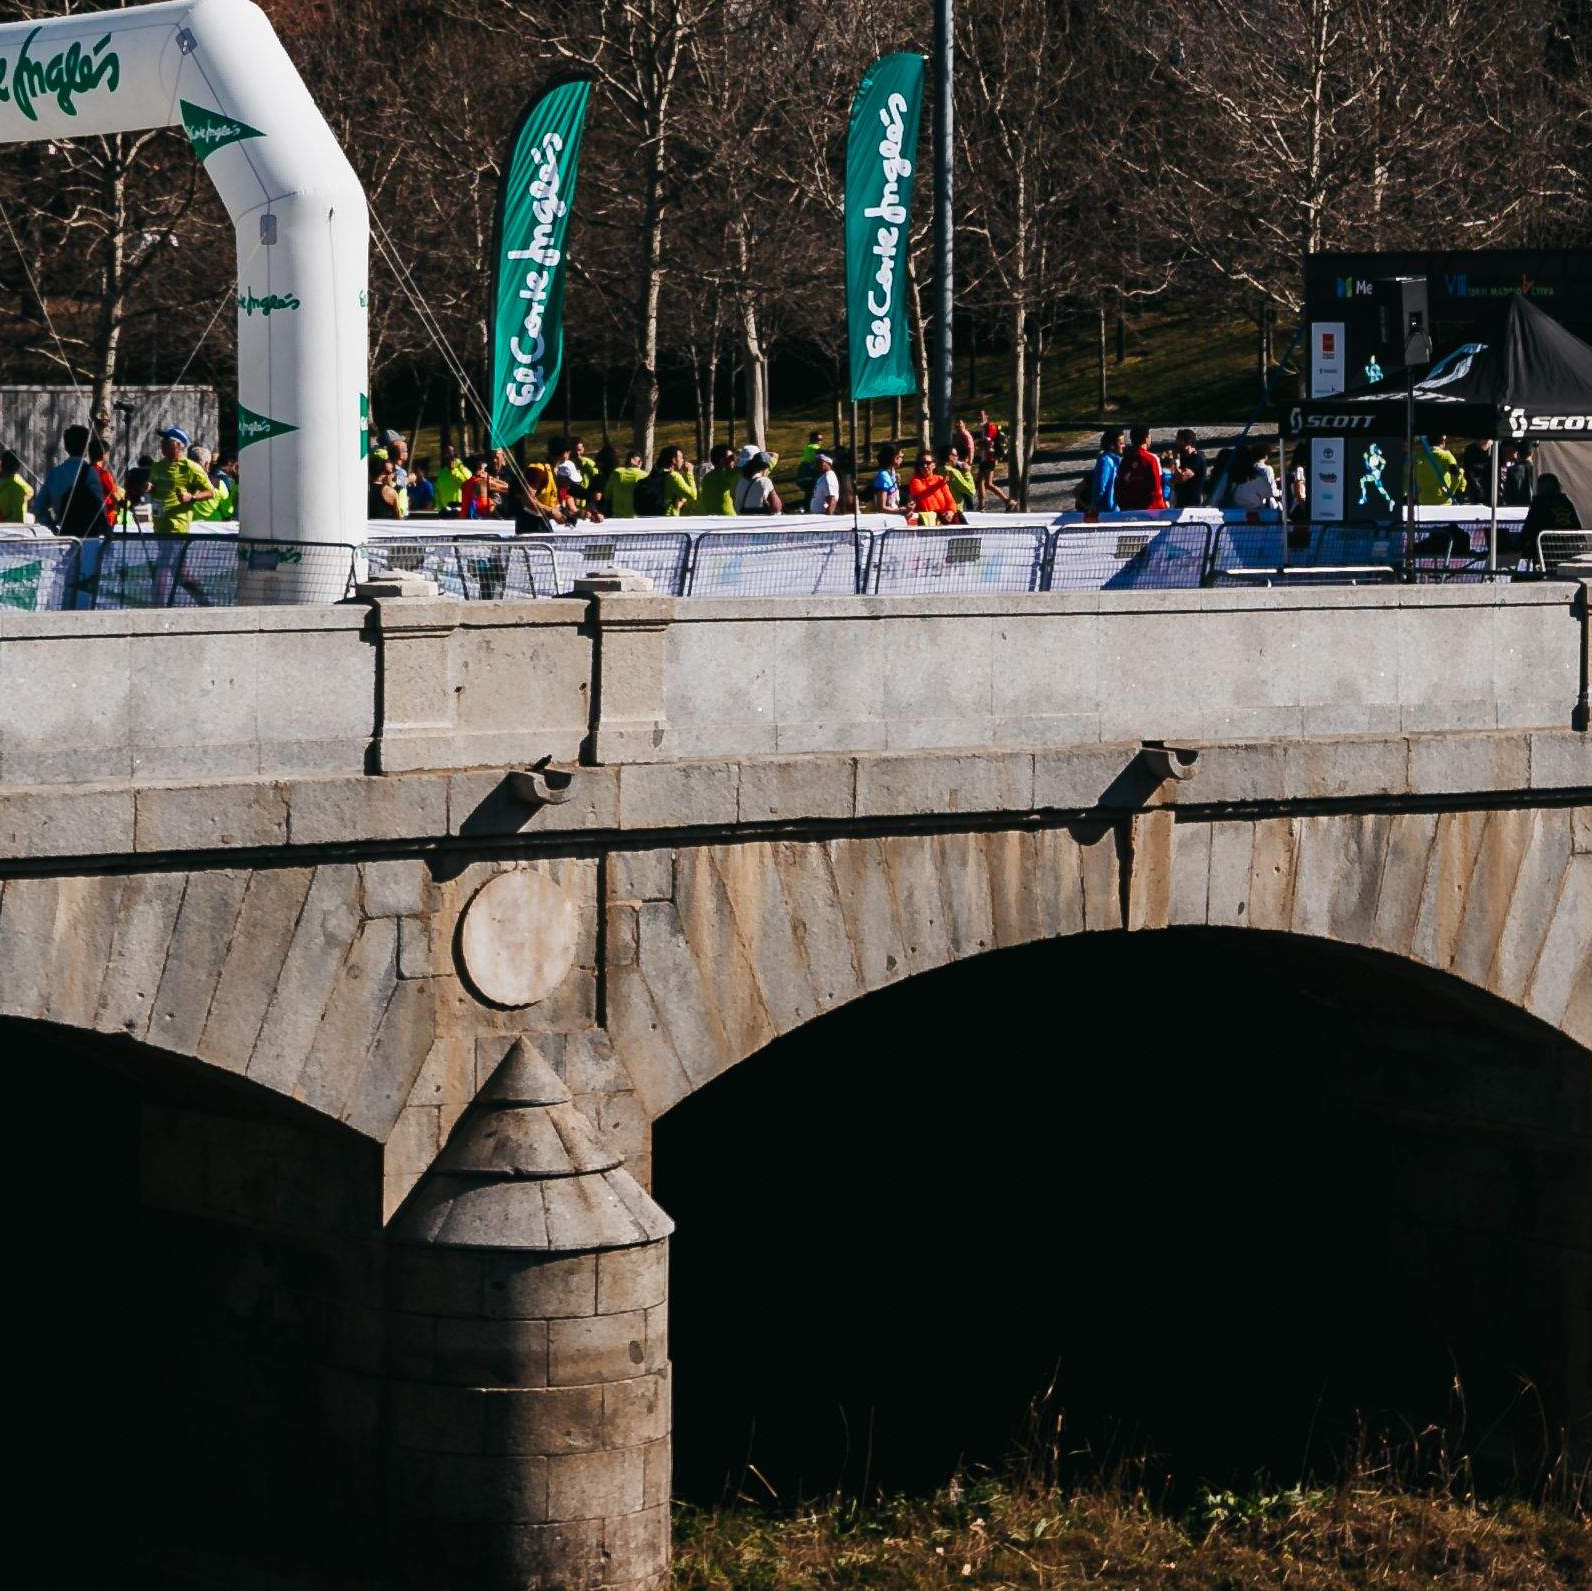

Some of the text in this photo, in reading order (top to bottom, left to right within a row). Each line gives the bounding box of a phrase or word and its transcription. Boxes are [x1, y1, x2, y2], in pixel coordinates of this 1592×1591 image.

[12, 25, 120, 122] Inglés
[506, 133, 567, 406] El Corte Inglés
[864, 93, 912, 358] El Corte Inglés
[1307, 414, 1376, 428] SCOTT
